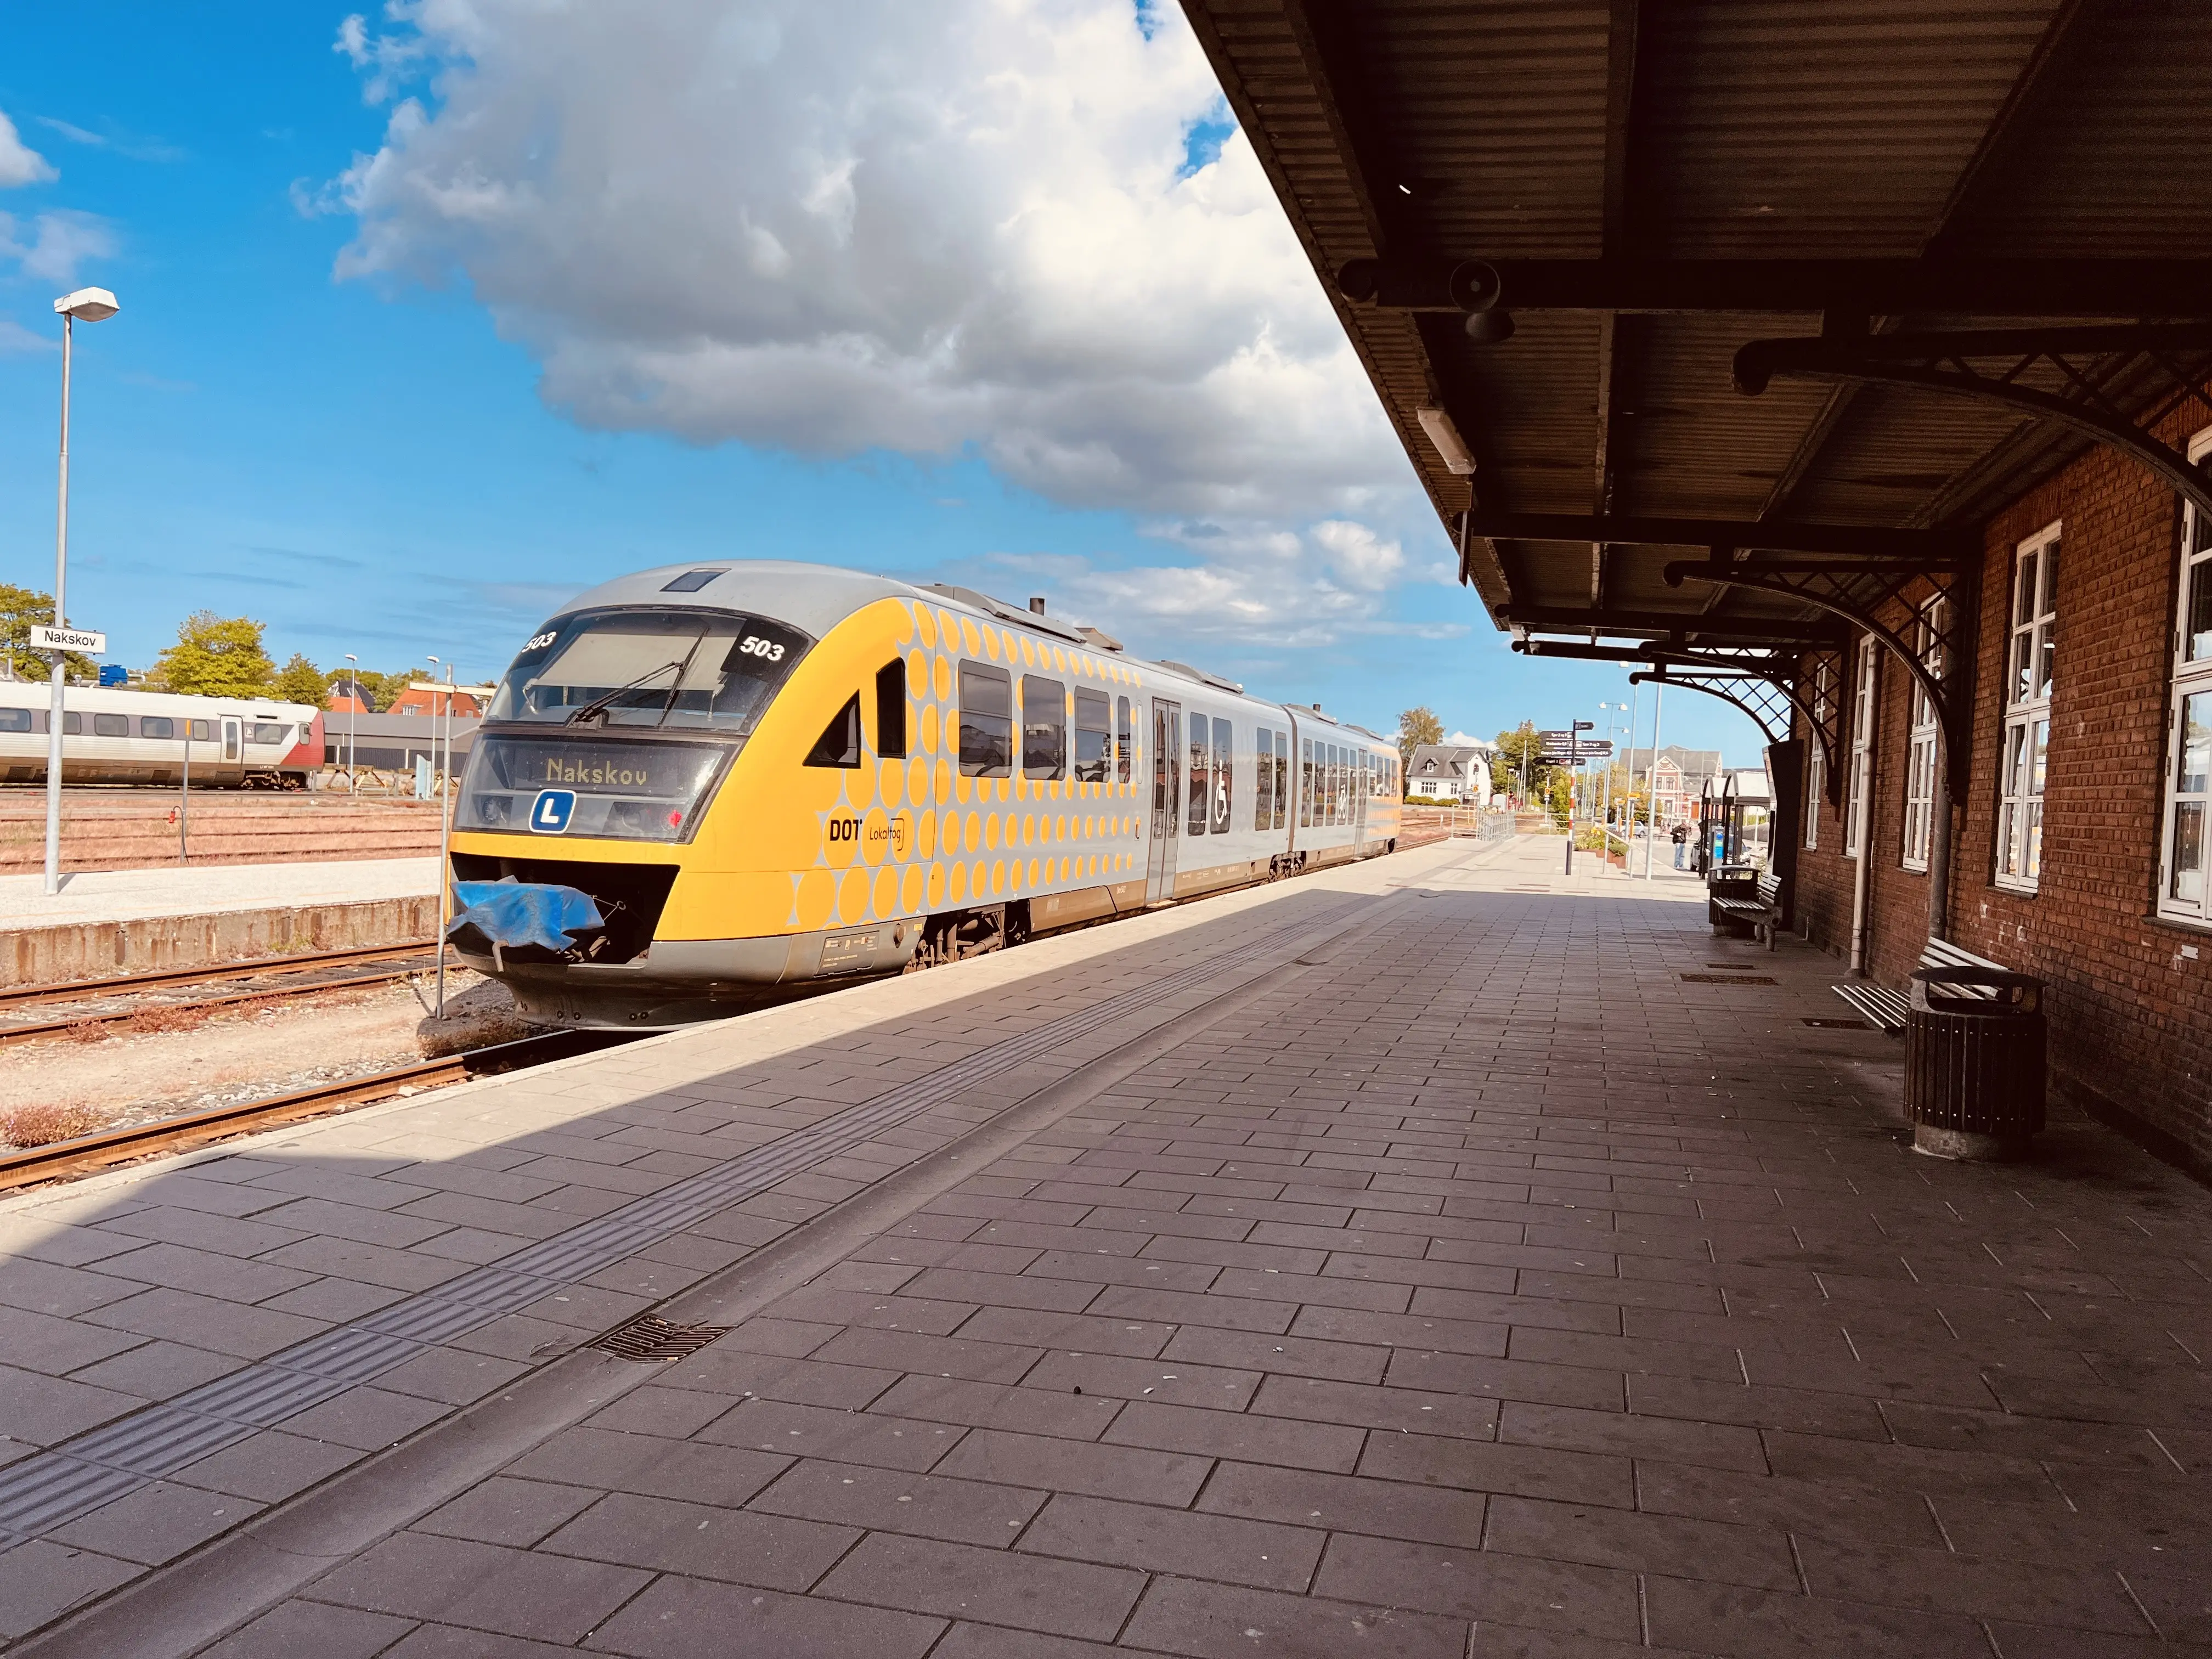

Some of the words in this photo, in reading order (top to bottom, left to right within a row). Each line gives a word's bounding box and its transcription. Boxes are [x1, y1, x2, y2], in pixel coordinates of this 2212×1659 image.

[44, 630, 96, 646] Nakskov
[522, 631, 557, 653] 503
[740, 636, 785, 661] 503
[547, 758, 647, 786] Nakskov
[540, 798, 560, 823] L
[830, 819, 859, 841] DOT
[870, 826, 901, 843] Lokaltog
